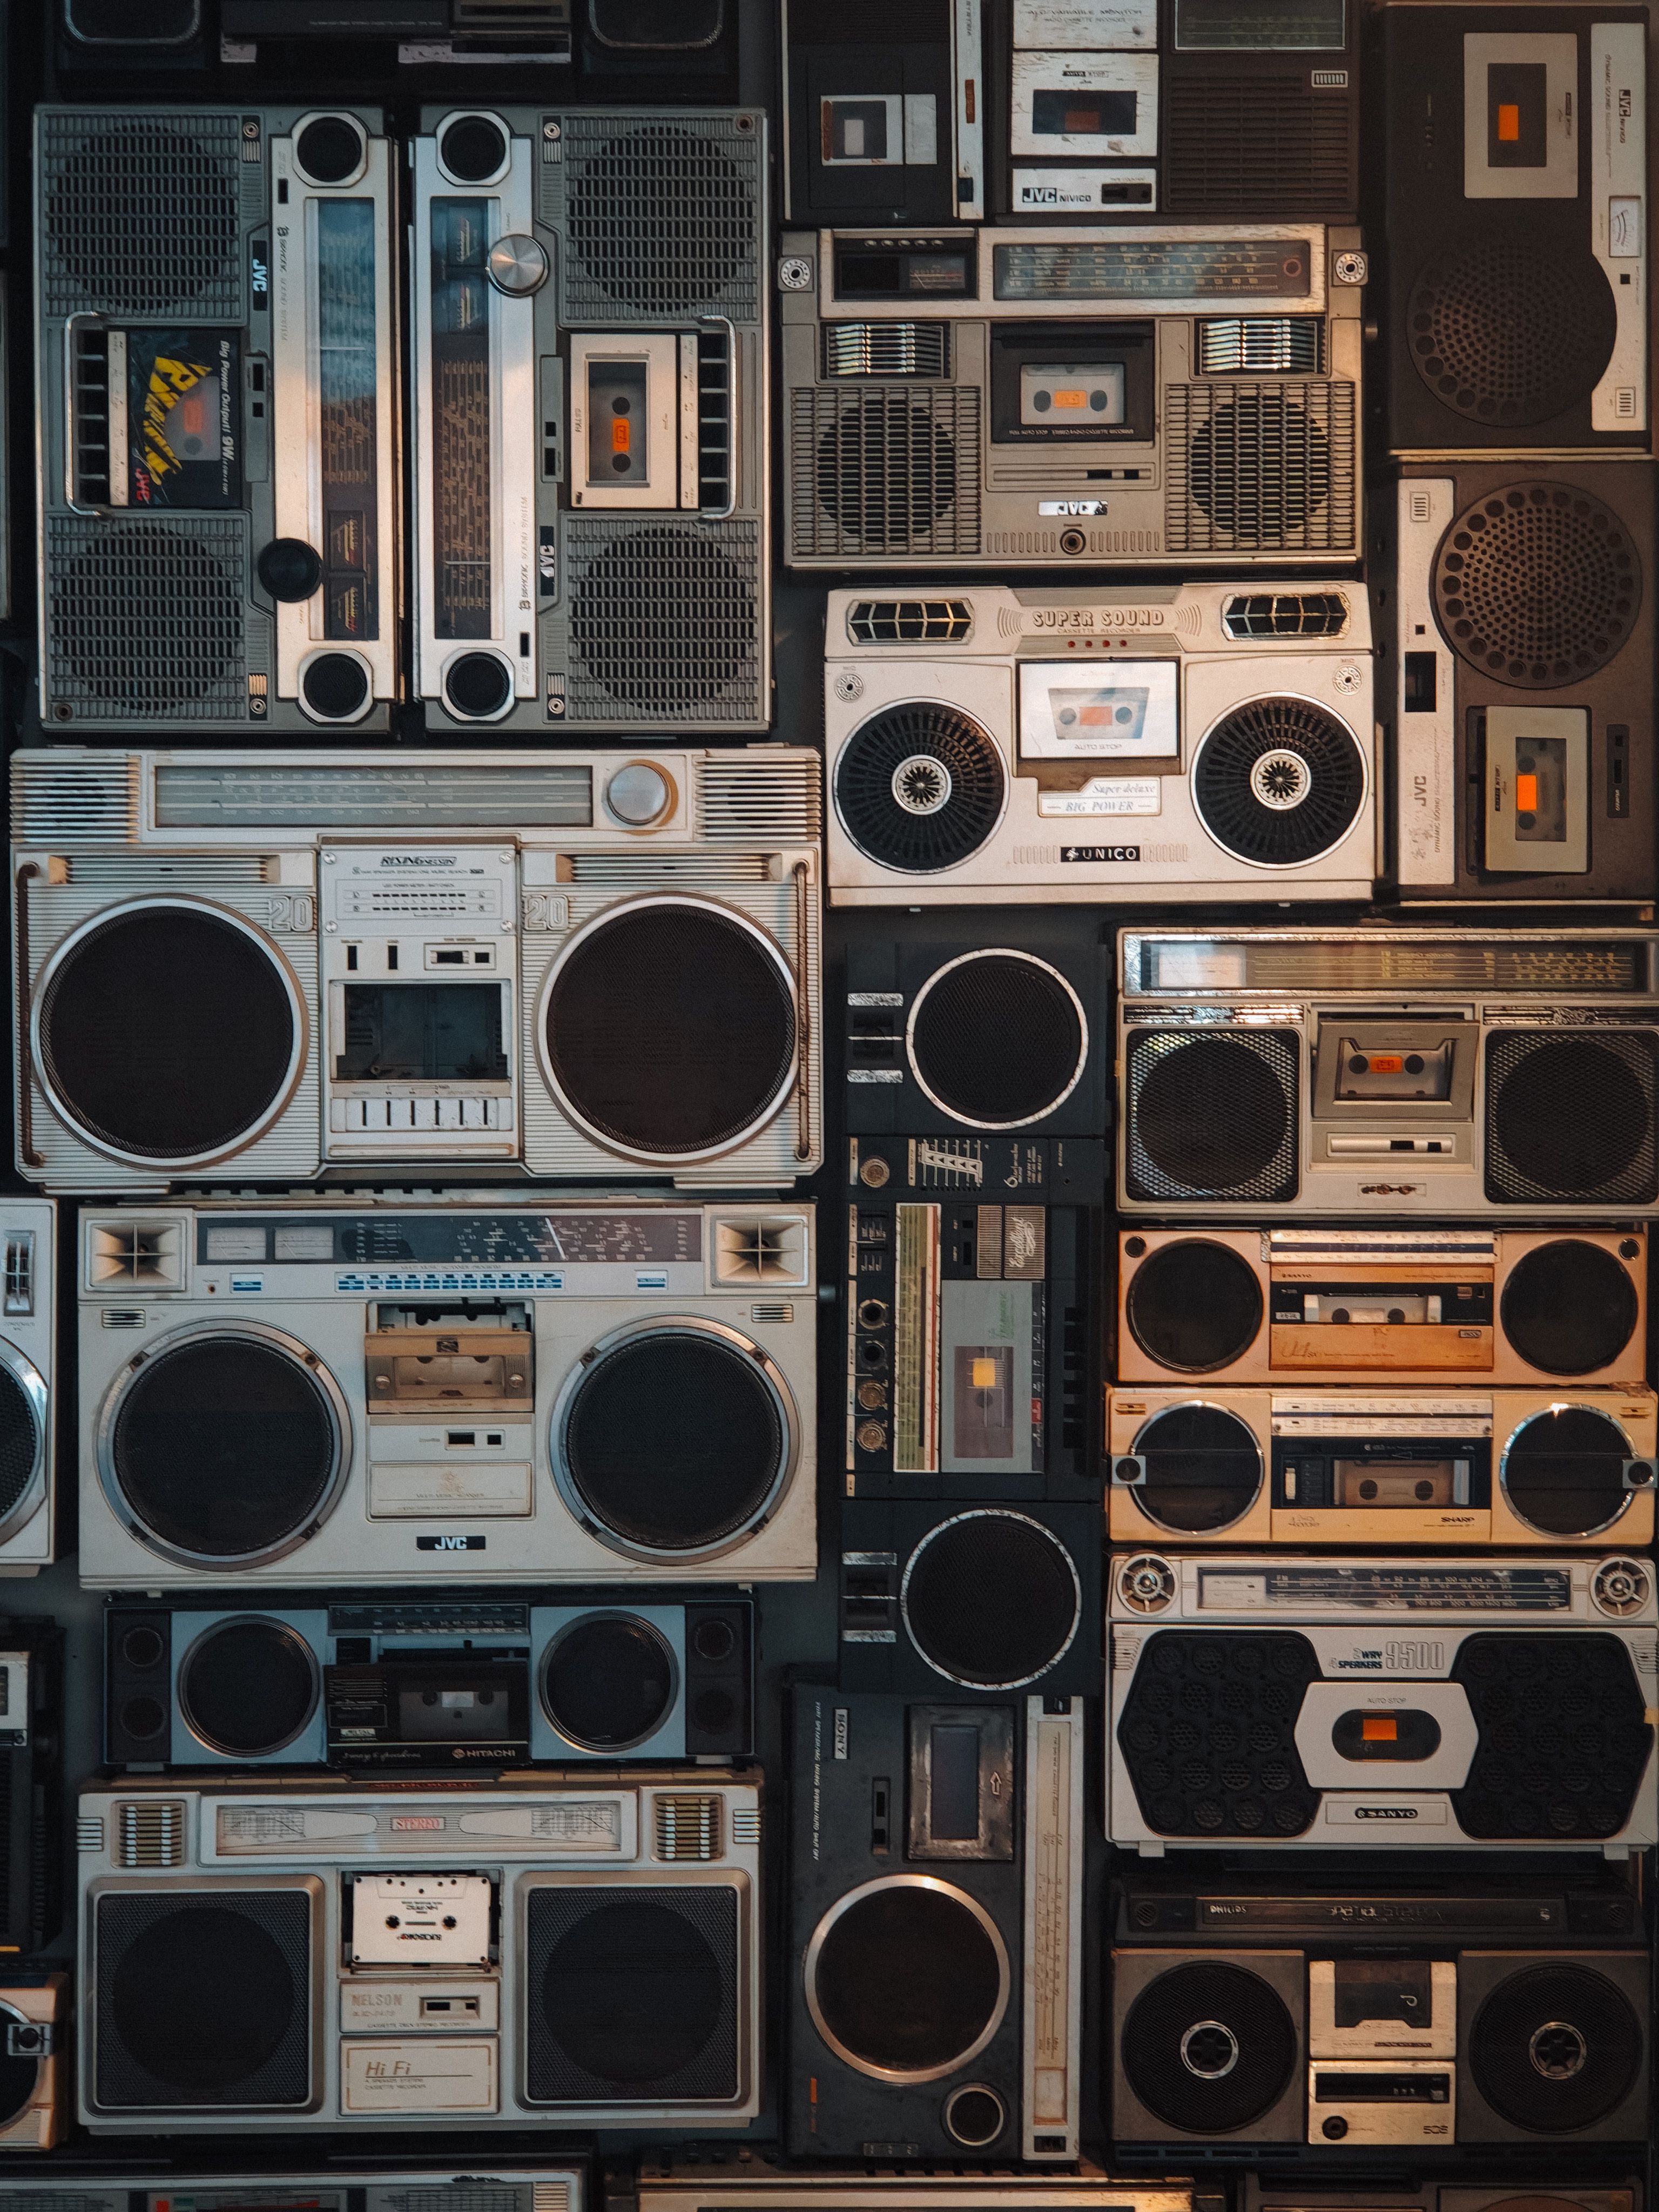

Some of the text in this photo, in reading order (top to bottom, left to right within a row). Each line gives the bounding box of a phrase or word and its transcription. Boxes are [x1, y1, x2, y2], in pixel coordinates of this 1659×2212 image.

[1620, 90, 1630, 116] JVC
[1023, 188, 1056, 203] JVC
[253, 259, 267, 292] JVC
[220, 340, 230, 358] Big
[221, 360, 230, 392] Power
[540, 545, 555, 578] JVC
[1032, 609, 1164, 627] SUPER SOUND
[1092, 783, 1123, 795] Super
[1414, 776, 1427, 806] JVC
[1065, 801, 1134, 812] BIG POWER
[1082, 847, 1137, 861] UNICO
[269, 895, 313, 932] 20
[525, 894, 569, 930] 20
[1008, 1217, 1024, 1267] Excellent
[435, 1536, 467, 1550] JVC
[1338, 1660, 1382, 1669] SPEAKERS
[1386, 1641, 1445, 1670] 9500
[396, 1818, 441, 1830] STEREO
[352, 1994, 402, 2006] NELSON
[365, 2061, 411, 2076] Hi Fi
